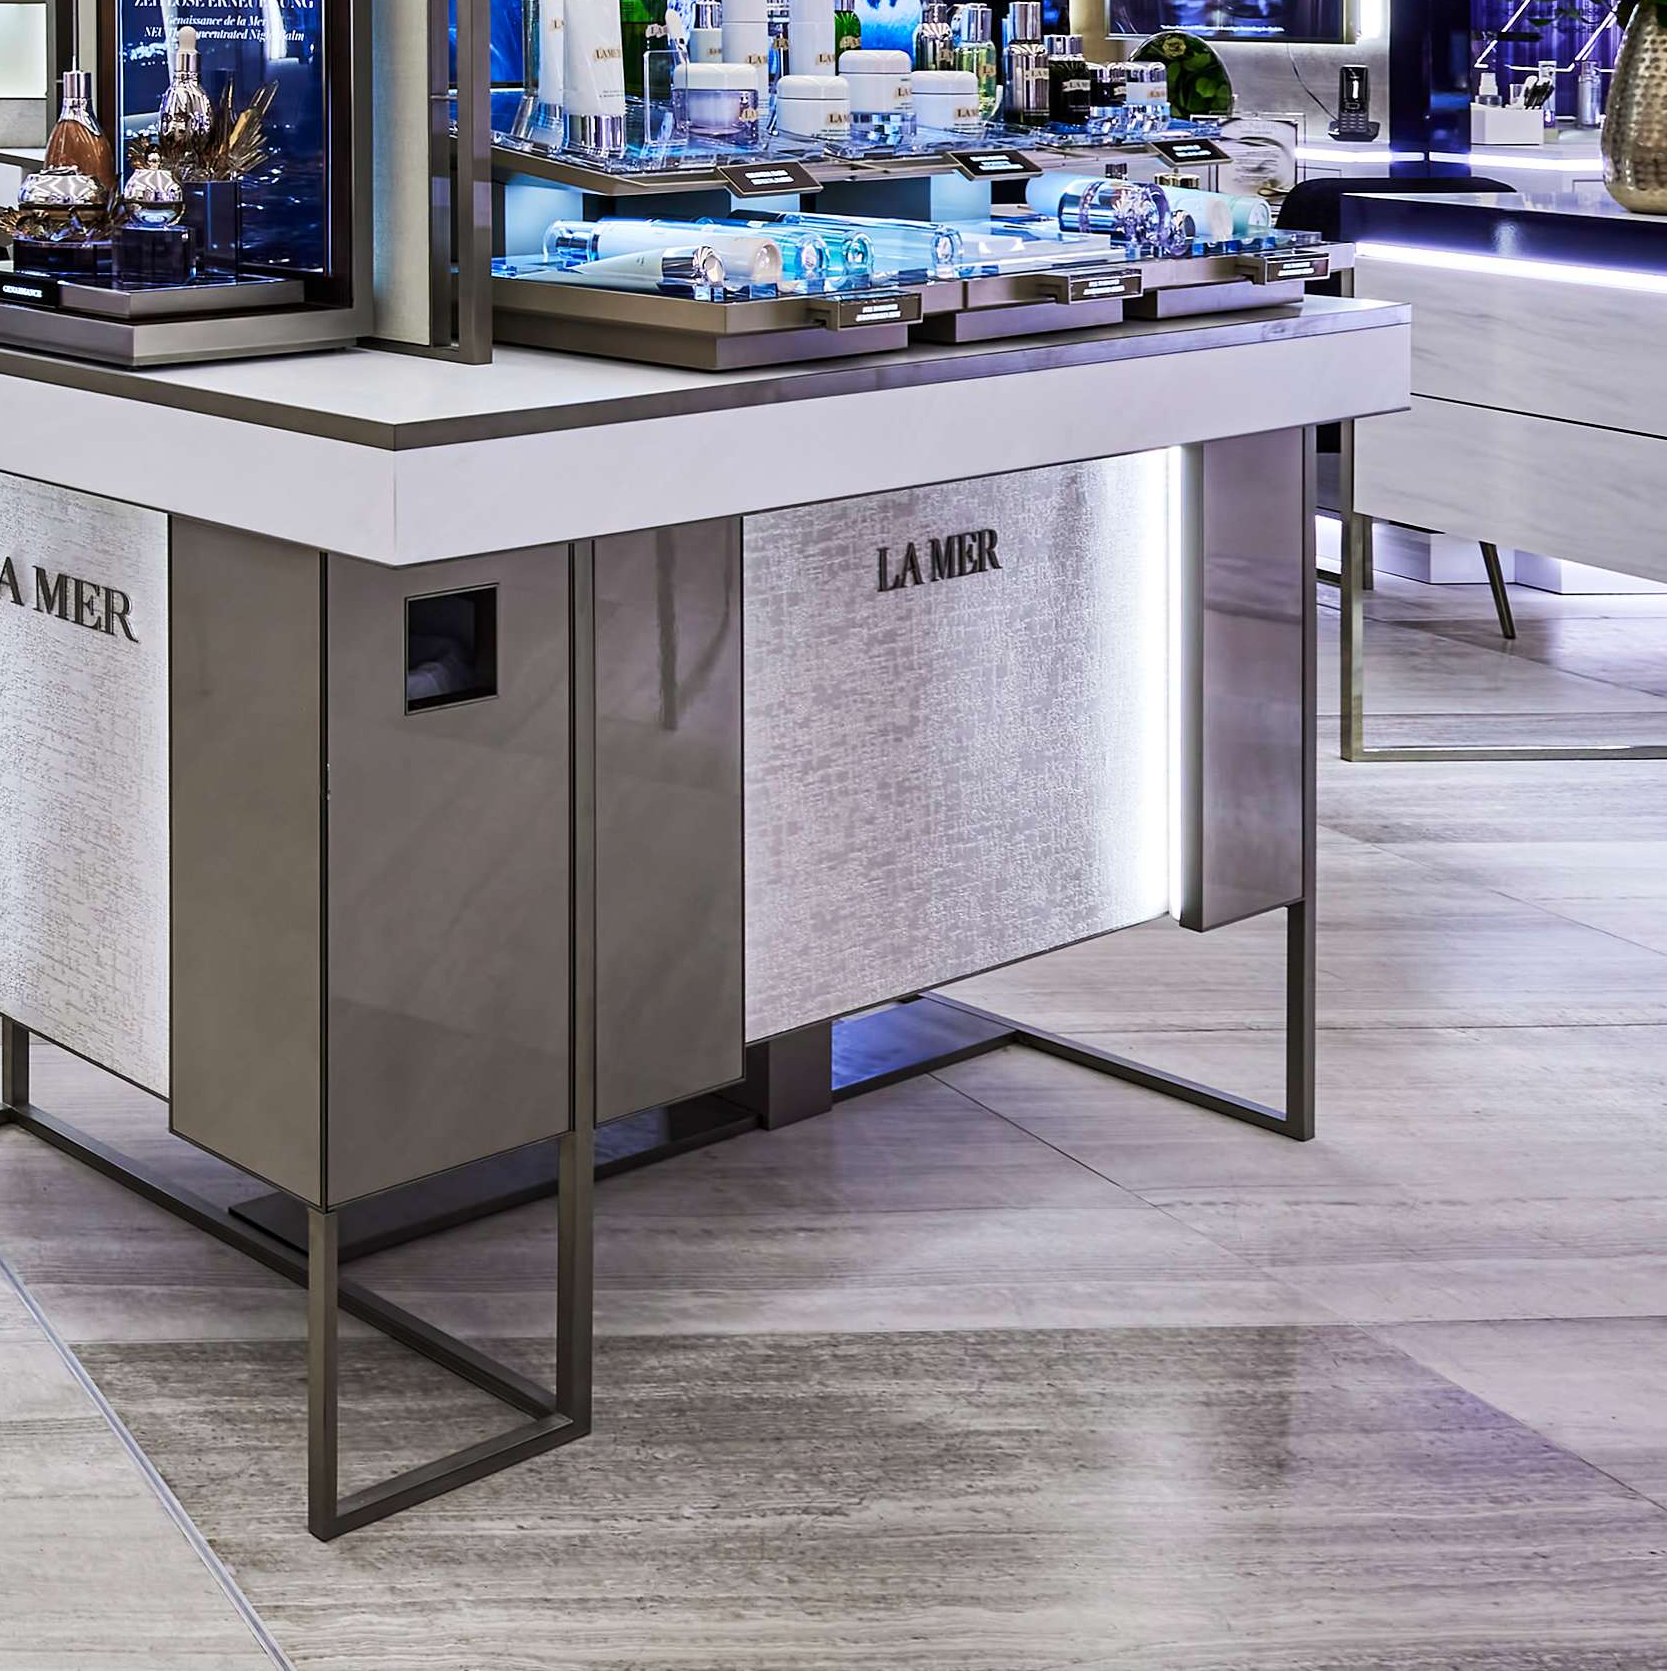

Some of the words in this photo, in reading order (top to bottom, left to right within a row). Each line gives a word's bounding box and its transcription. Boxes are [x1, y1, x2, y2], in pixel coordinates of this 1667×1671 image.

[223, 15, 236, 26] de
[236, 15, 247, 27] la
[247, 15, 267, 28] Mer
[876, 541, 926, 593] LA
[928, 528, 1004, 583] MER
[31, 564, 140, 644] MER
